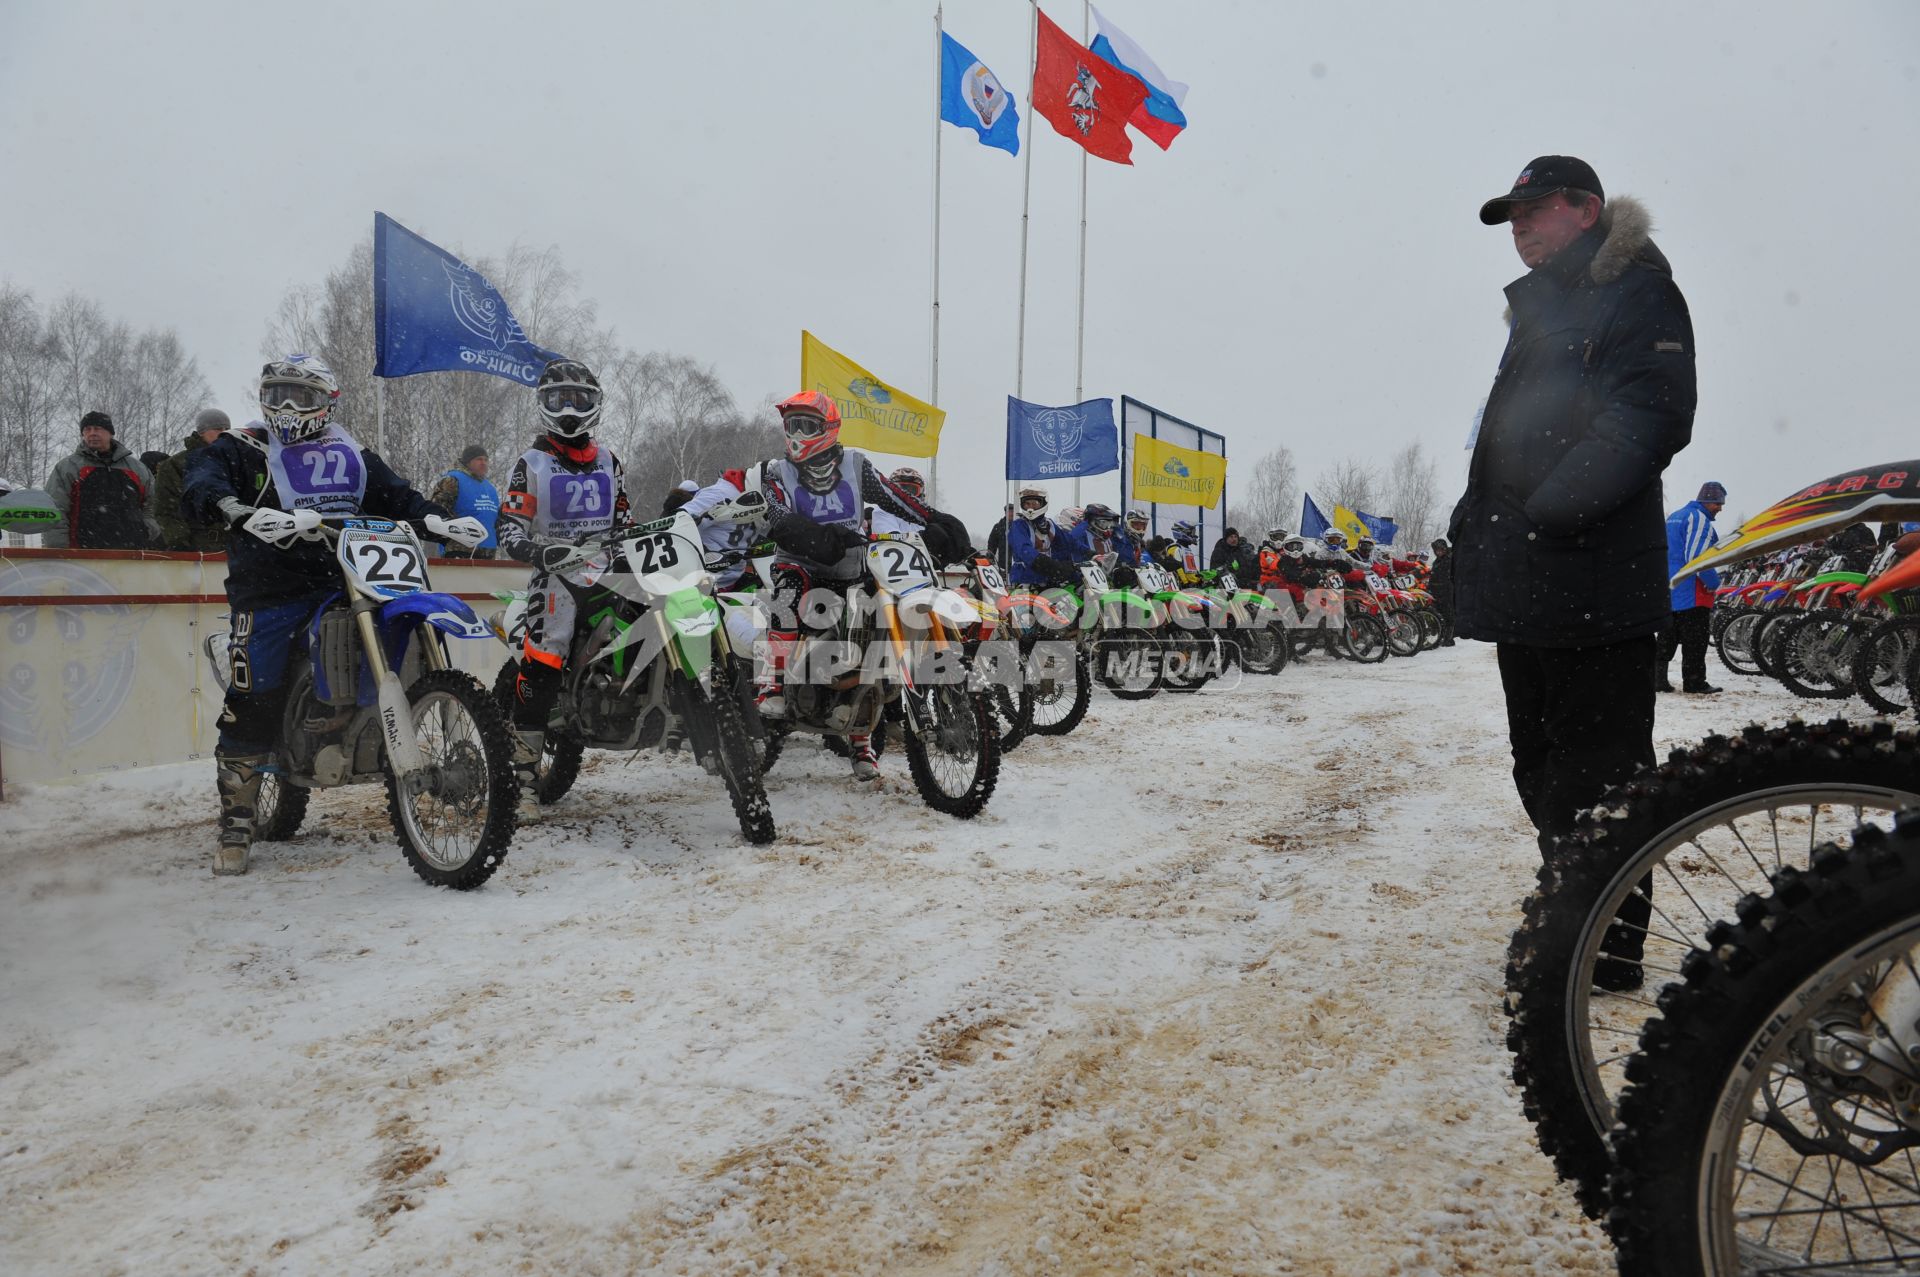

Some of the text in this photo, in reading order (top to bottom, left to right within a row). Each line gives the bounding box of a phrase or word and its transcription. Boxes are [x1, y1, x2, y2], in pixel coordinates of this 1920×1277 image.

[460, 350, 537, 382] ФЕНИКС
[302, 449, 350, 487] 22
[1039, 462, 1081, 473] ФЕНИКС
[565, 479, 602, 513] 23
[1797, 472, 1920, 501] RAC
[1, 510, 57, 519] ACERBIS
[808, 490, 845, 517] 24
[358, 544, 423, 585] 22
[635, 532, 679, 577] 23
[883, 547, 930, 578] 24
[982, 568, 1003, 588] 62
[1089, 569, 1106, 585] 10
[1741, 1013, 1793, 1073] EXCEL
